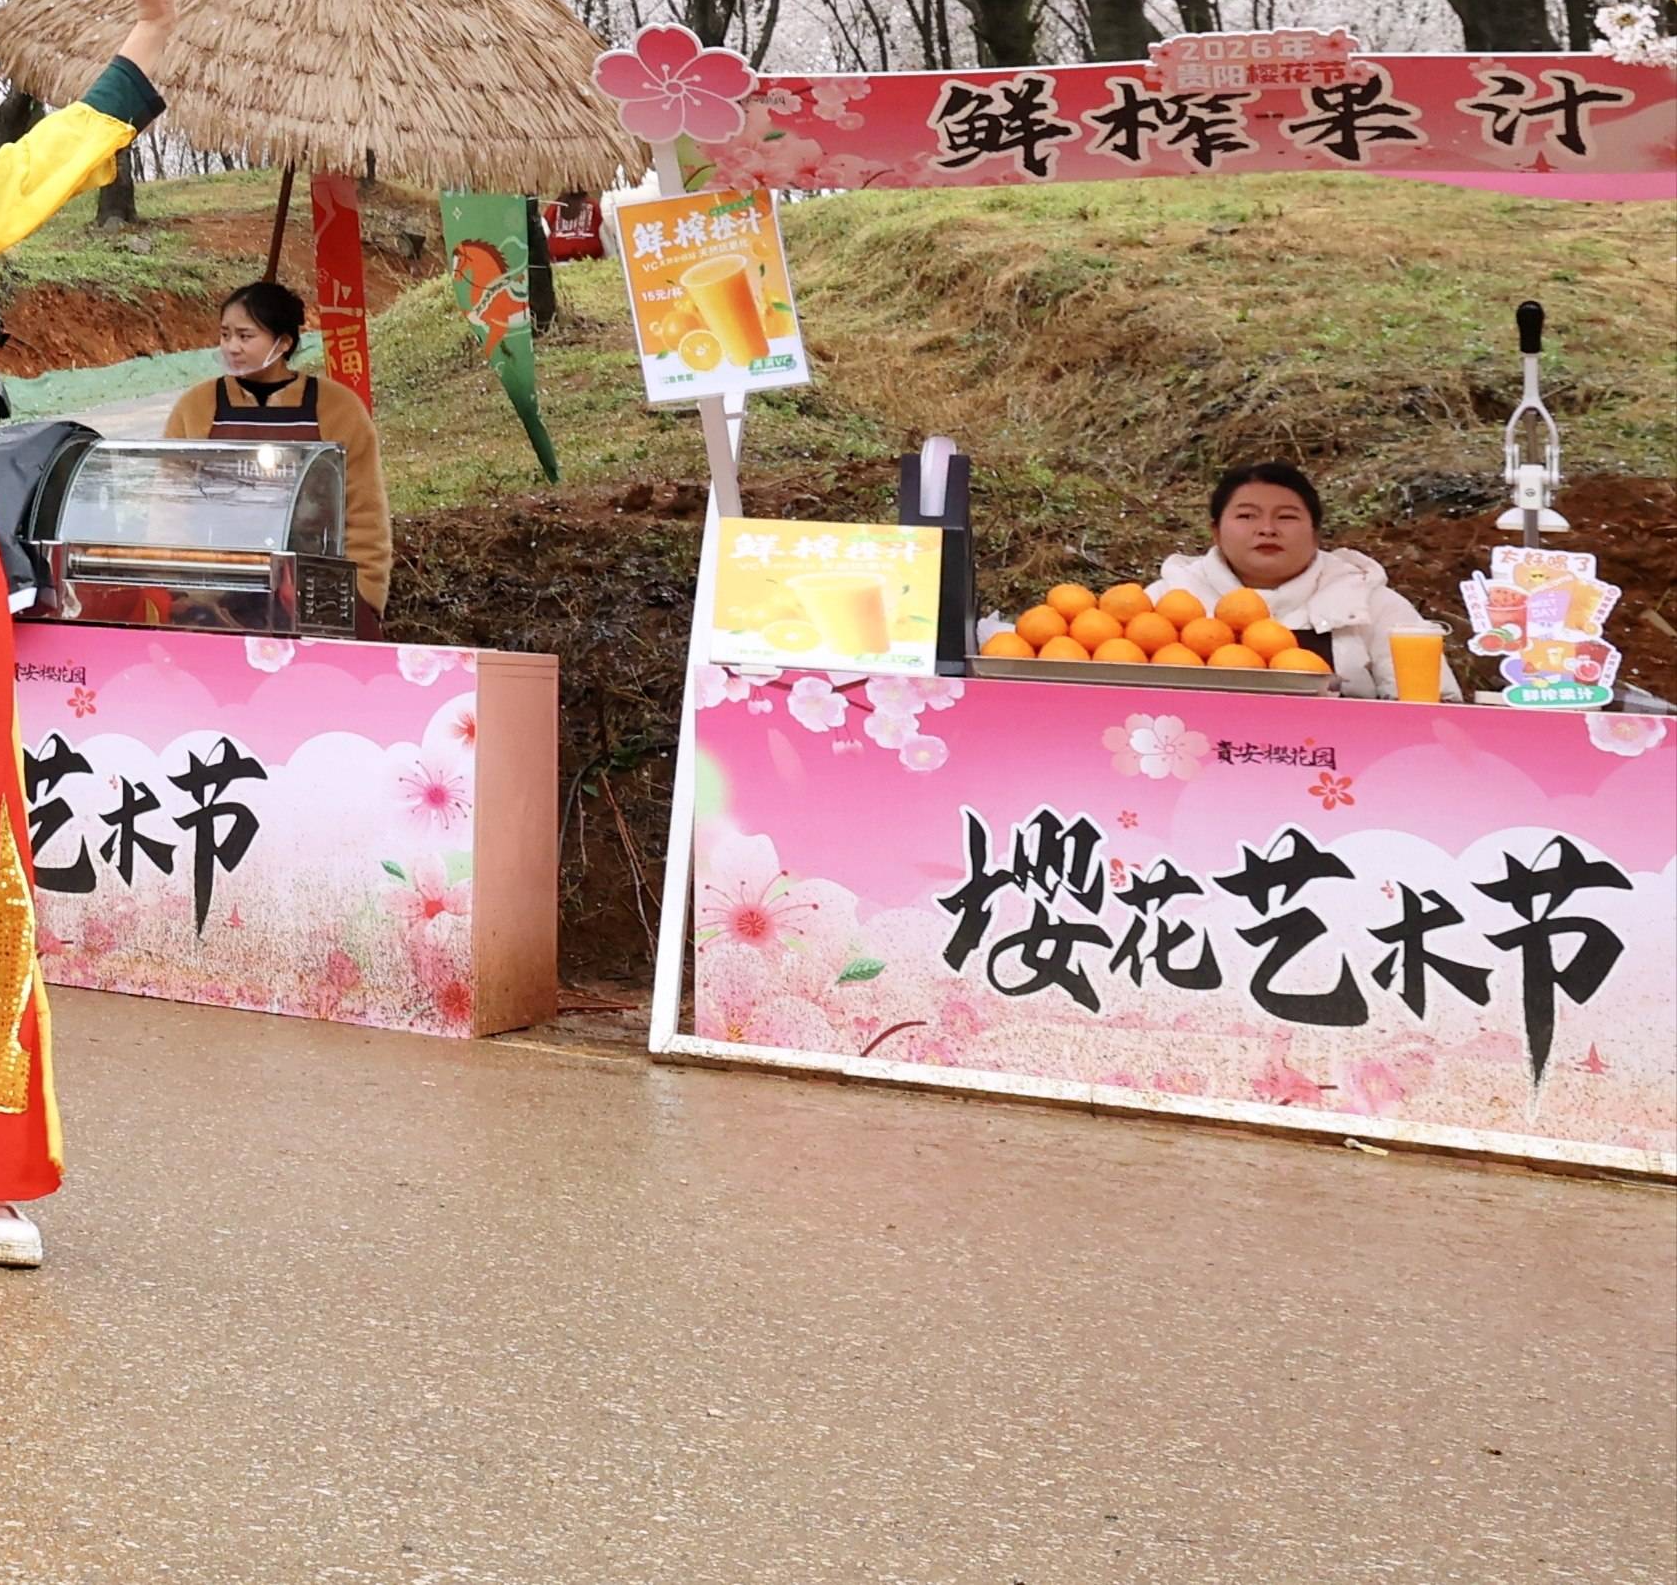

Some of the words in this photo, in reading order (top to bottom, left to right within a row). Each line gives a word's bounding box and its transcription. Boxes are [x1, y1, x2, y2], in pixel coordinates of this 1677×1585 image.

[1177, 61, 1347, 90] 贵阳樱花节
[1180, 35, 1315, 61] 2026年
[937, 77, 1625, 177] 鲜榨果汁
[936, 808, 1635, 1092] 樱花艺术节
